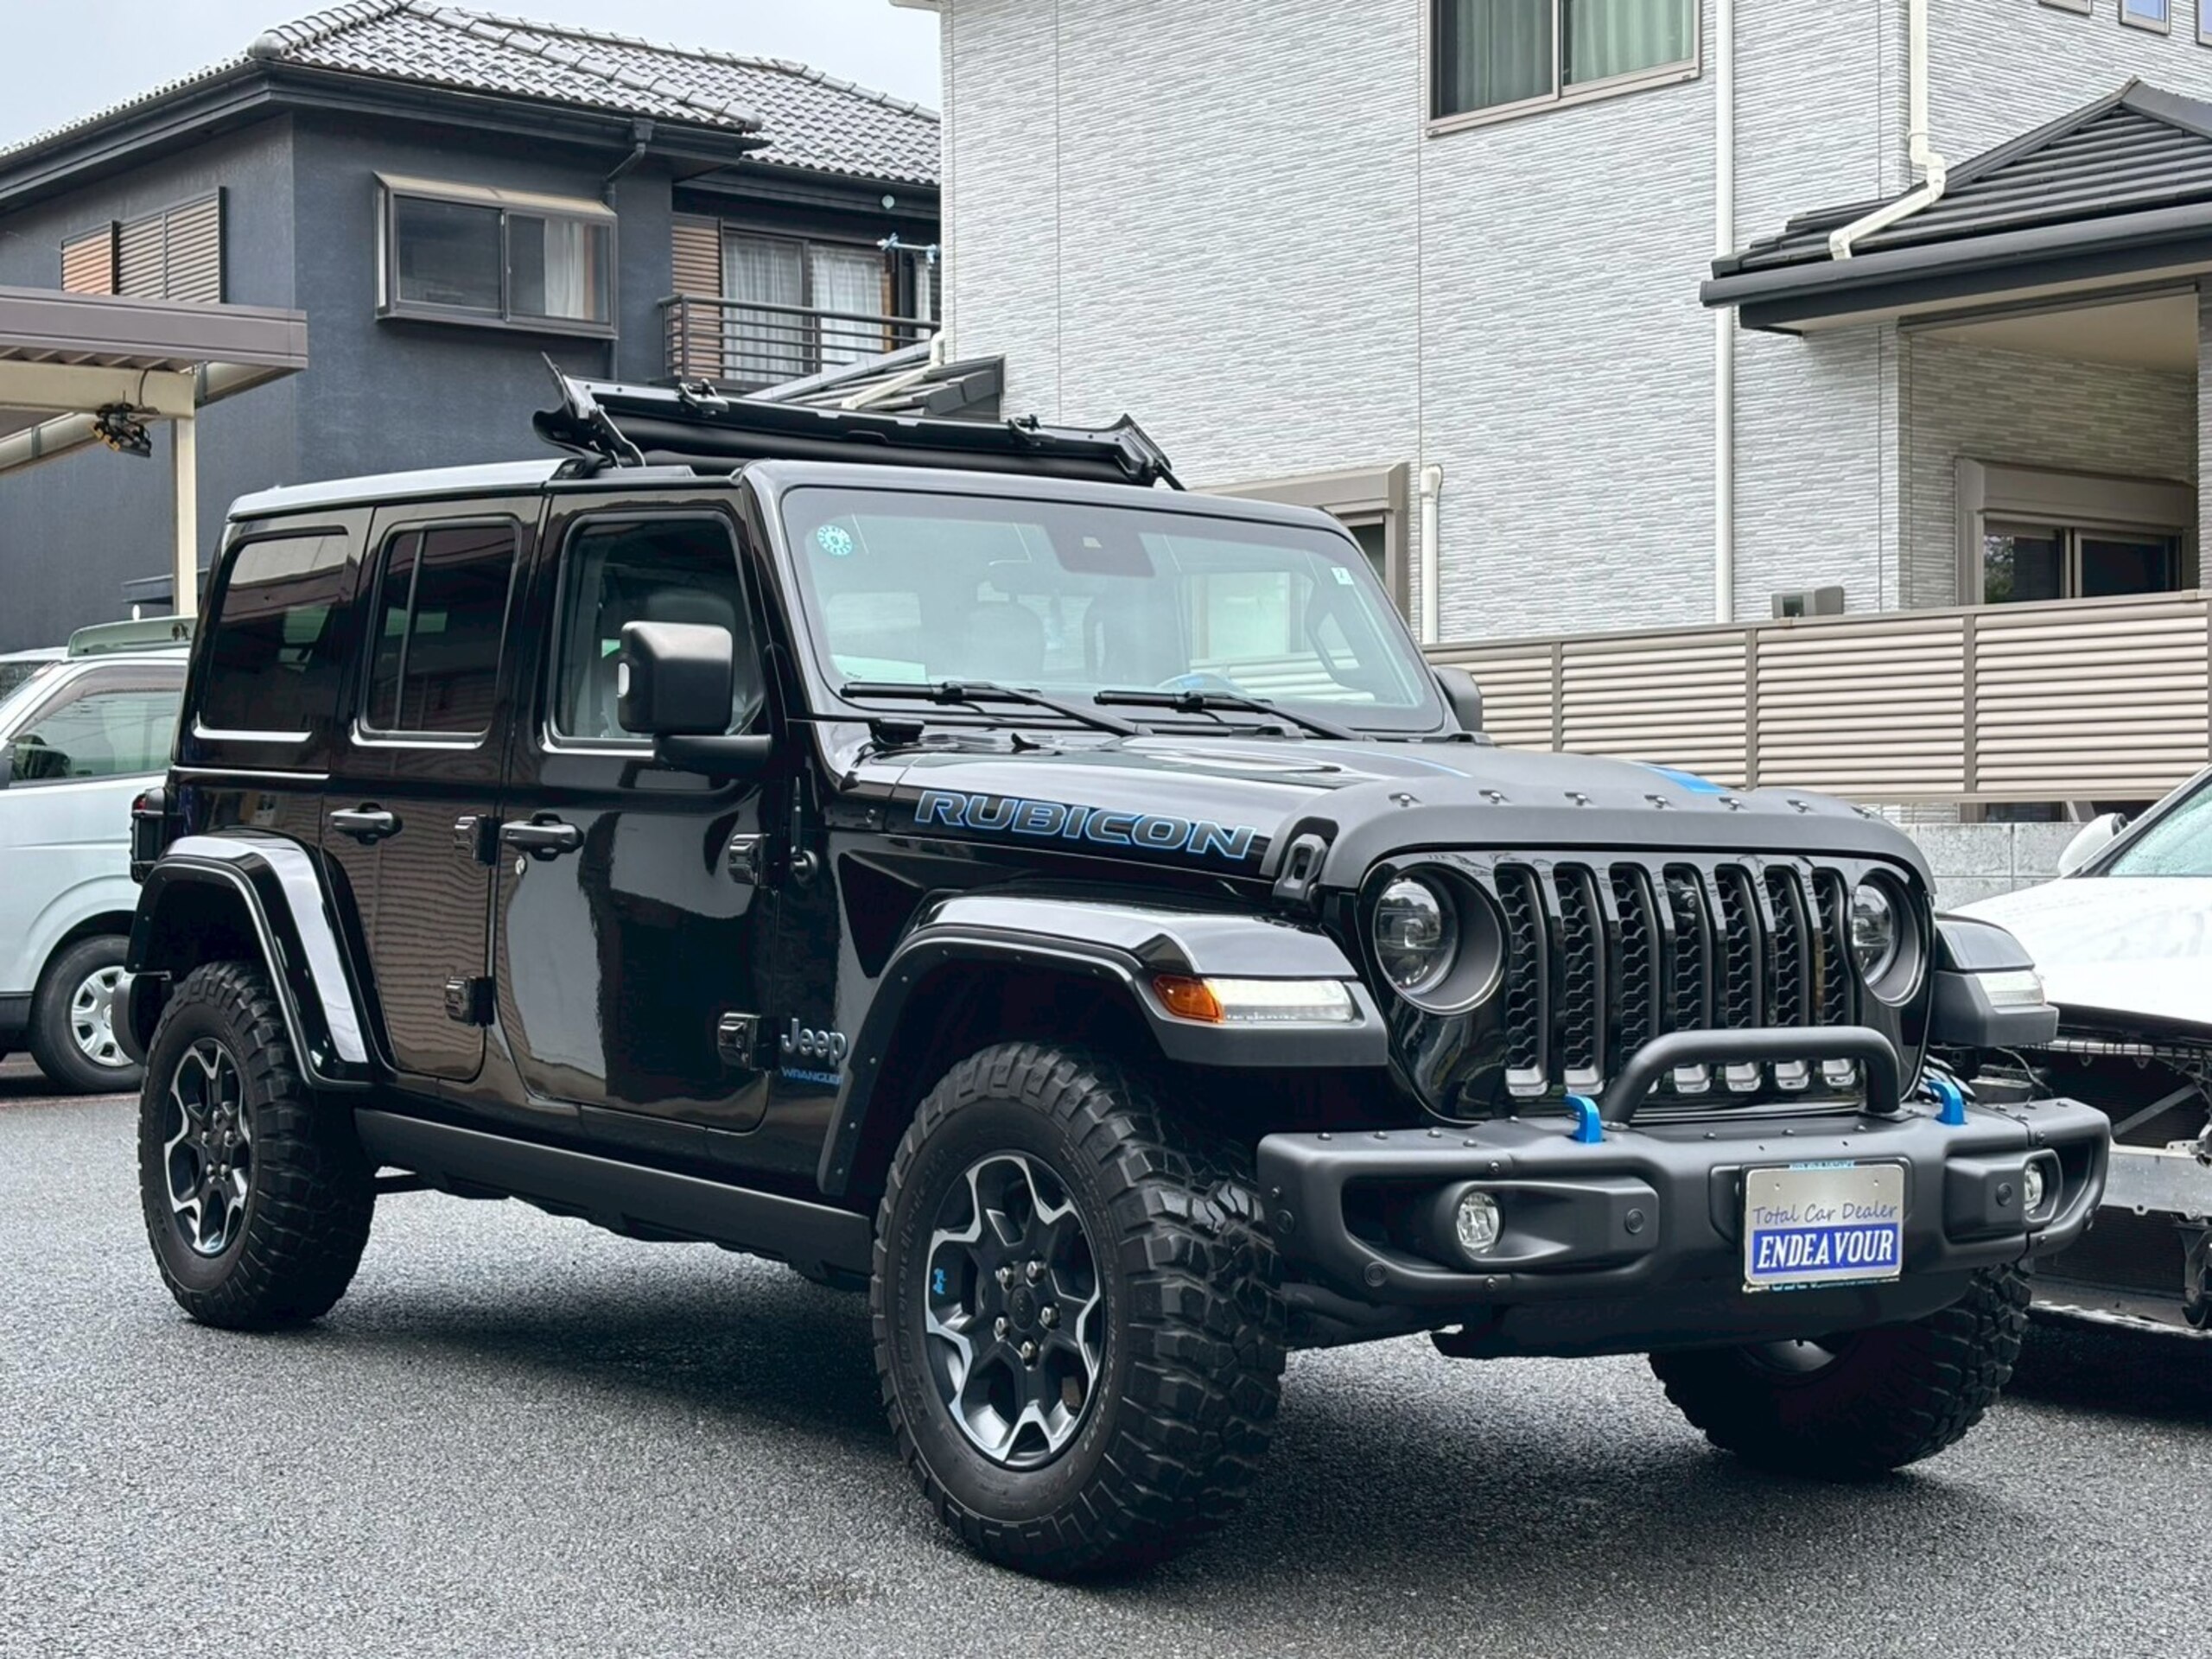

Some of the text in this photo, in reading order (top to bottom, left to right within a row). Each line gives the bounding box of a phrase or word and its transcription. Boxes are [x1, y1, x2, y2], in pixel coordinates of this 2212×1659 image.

[914, 790, 1258, 860] RUBICON
[781, 1017, 848, 1067] Jeep
[1752, 1200, 1897, 1225] Total Car Dealer
[1757, 1229, 1895, 1269] ENDEAVOUR
